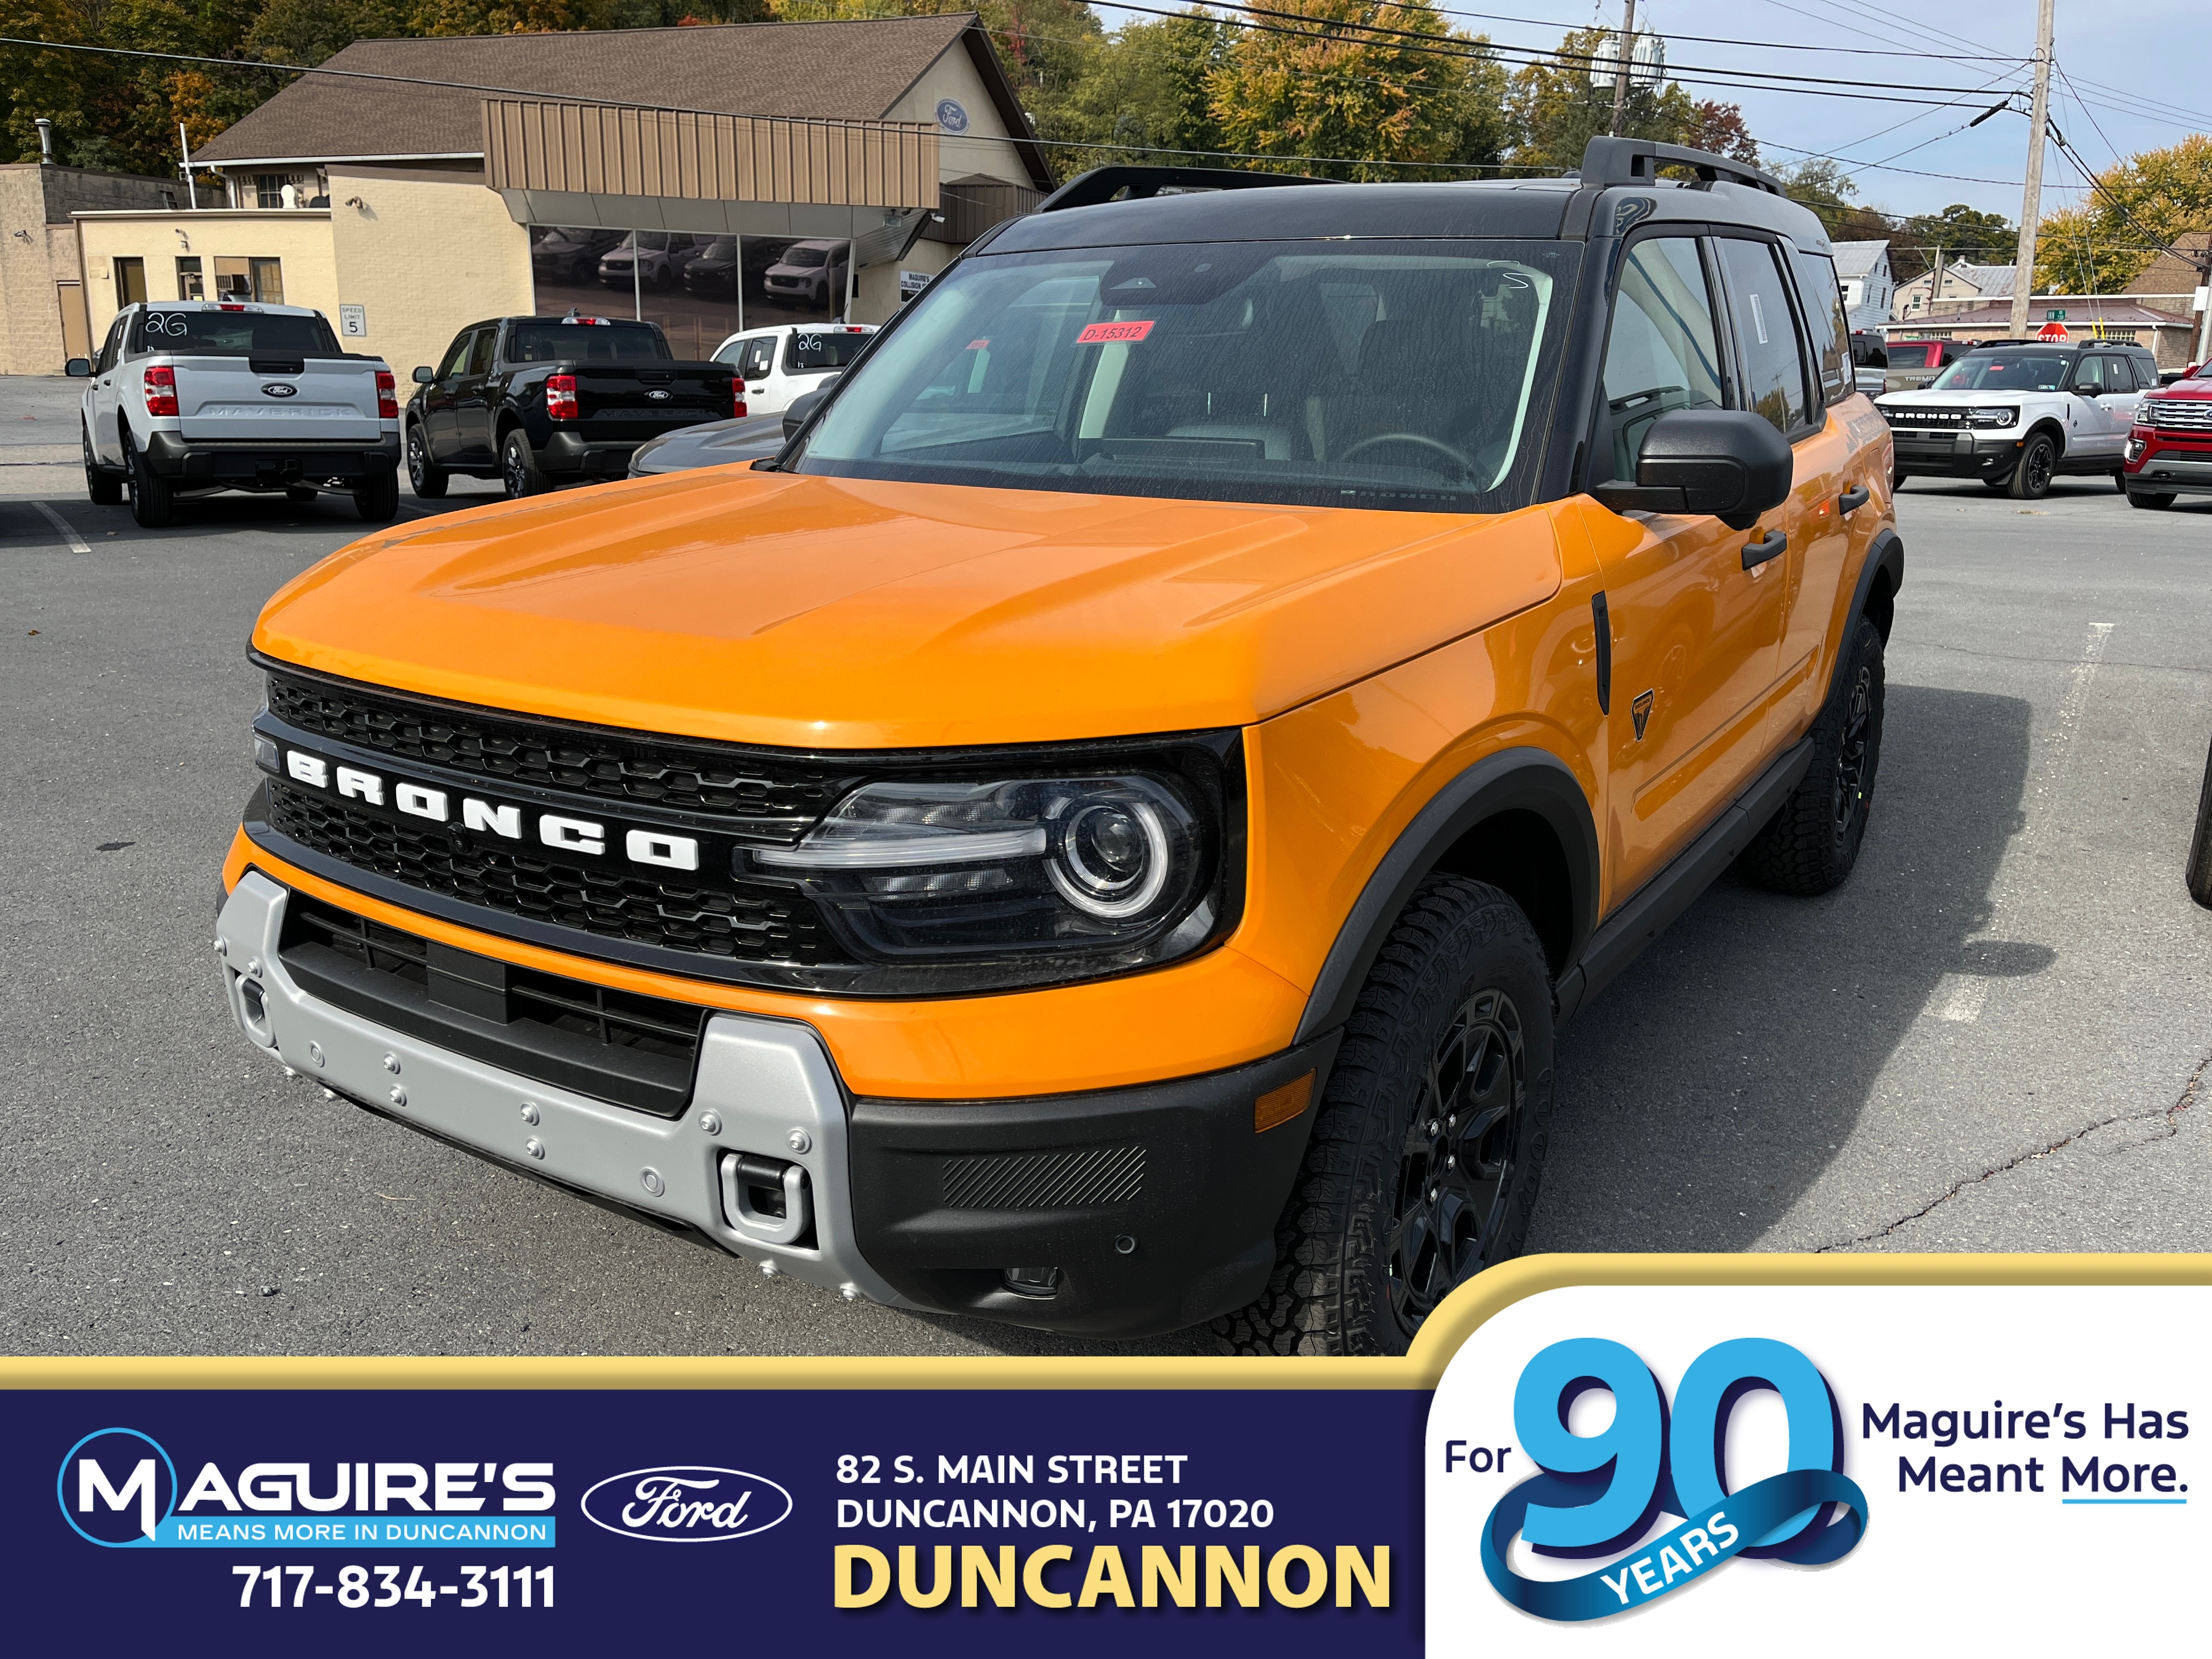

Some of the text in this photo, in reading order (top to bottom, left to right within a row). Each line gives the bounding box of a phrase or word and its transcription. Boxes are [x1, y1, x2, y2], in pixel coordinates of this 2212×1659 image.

[943, 104, 962, 128] Ford
[908, 273, 929, 283] MAGUIRE'S
[901, 280, 921, 289] COLLISION
[349, 321, 358, 332] 5
[1083, 327, 1143, 341] D-15312
[2038, 334, 2067, 342] STOP
[272, 385, 289, 394] Ford
[209, 407, 351, 416] MAVERICK
[287, 750, 699, 871] BRONCO
